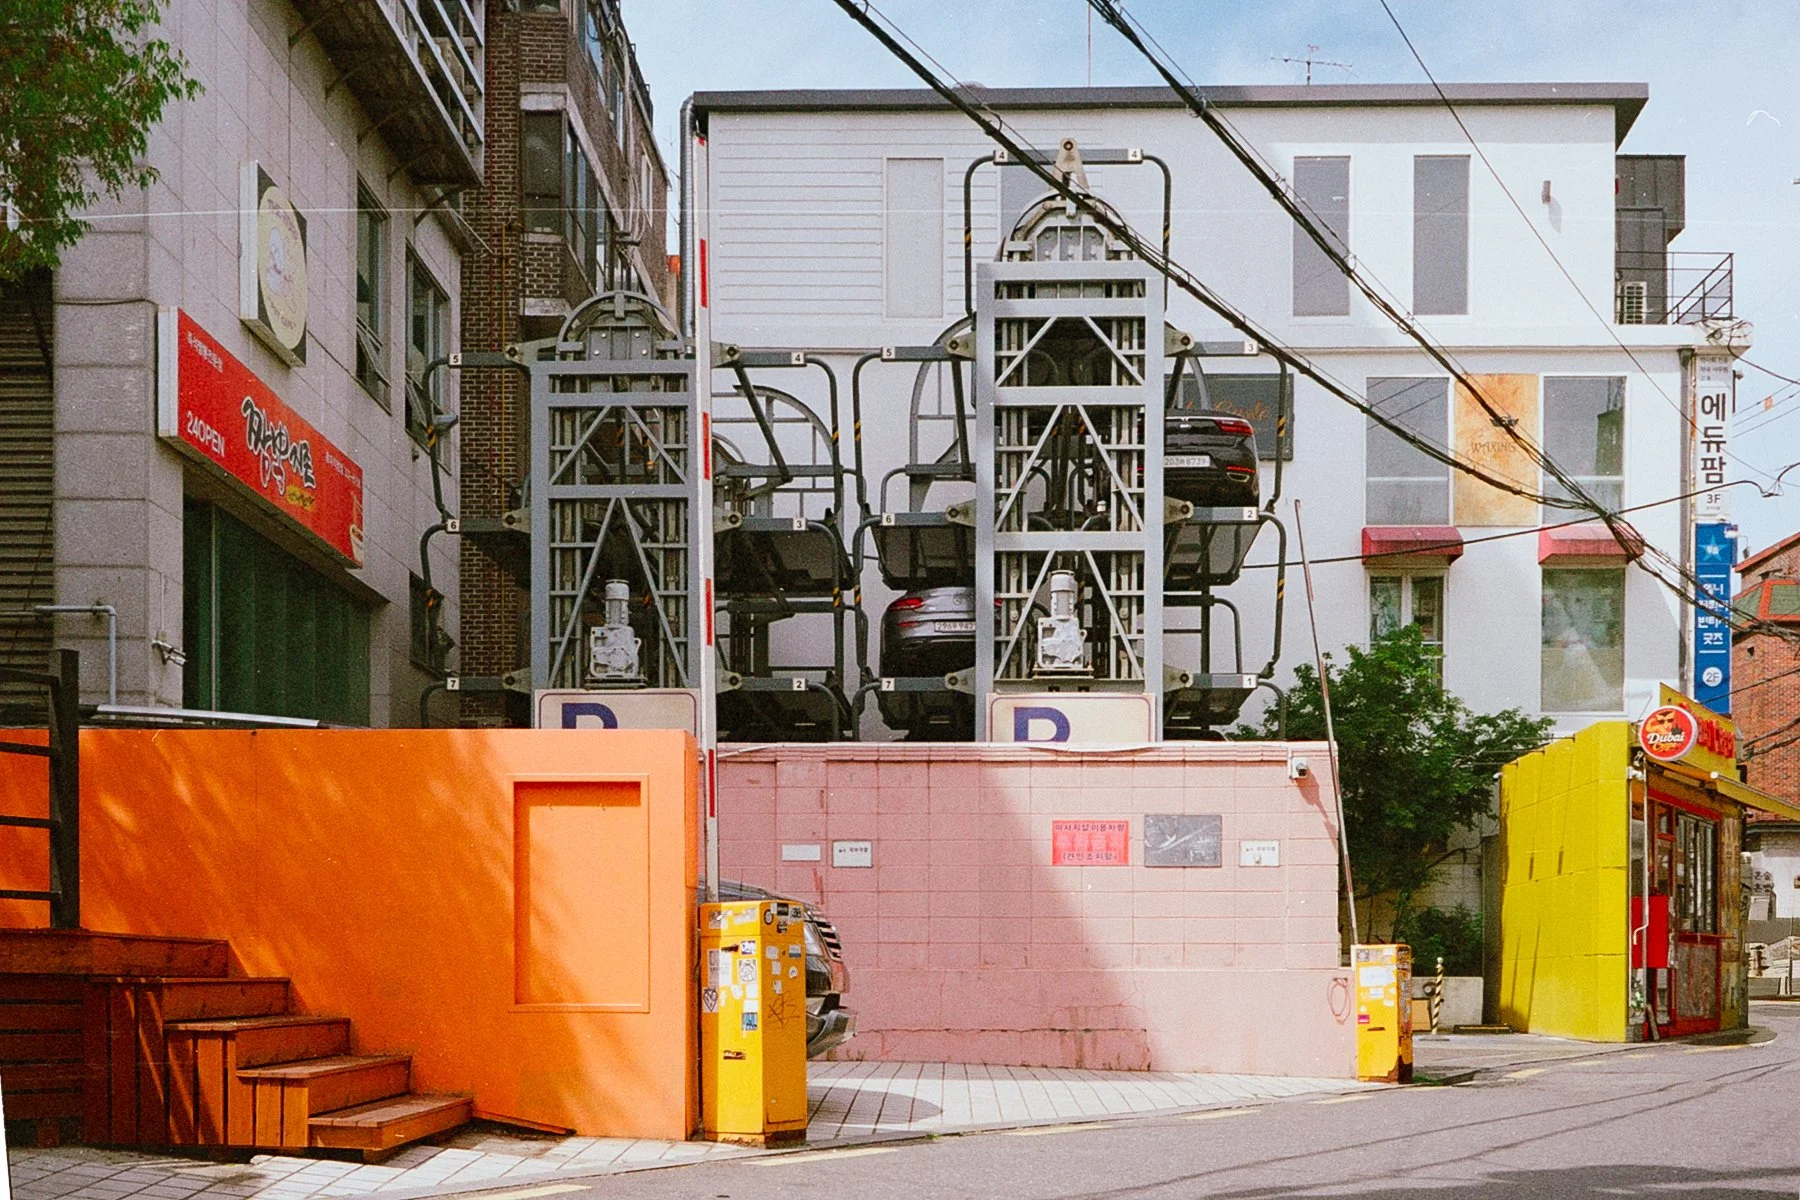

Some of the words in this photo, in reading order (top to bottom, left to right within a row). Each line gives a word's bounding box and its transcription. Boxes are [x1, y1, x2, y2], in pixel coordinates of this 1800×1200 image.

[998, 151, 1005, 160] 4
[1131, 150, 1138, 159] 4
[886, 347, 893, 357] 5
[1248, 343, 1255, 353] 3
[452, 354, 459, 364] 5
[794, 353, 802, 363] 4
[1700, 393, 1727, 485] 에듀팜
[1706, 493, 1721, 504] 3F
[885, 514, 892, 524] 6
[1247, 509, 1254, 519] 2
[450, 520, 457, 530] 6
[796, 519, 803, 529] 3
[1702, 632, 1724, 646] 굿즈
[1246, 676, 1253, 687] 1
[1706, 671, 1720, 683] 2F
[450, 679, 457, 689] 7
[796, 680, 803, 690] 2
[885, 680, 892, 690] 7
[1647, 731, 1684, 745] Dubai
